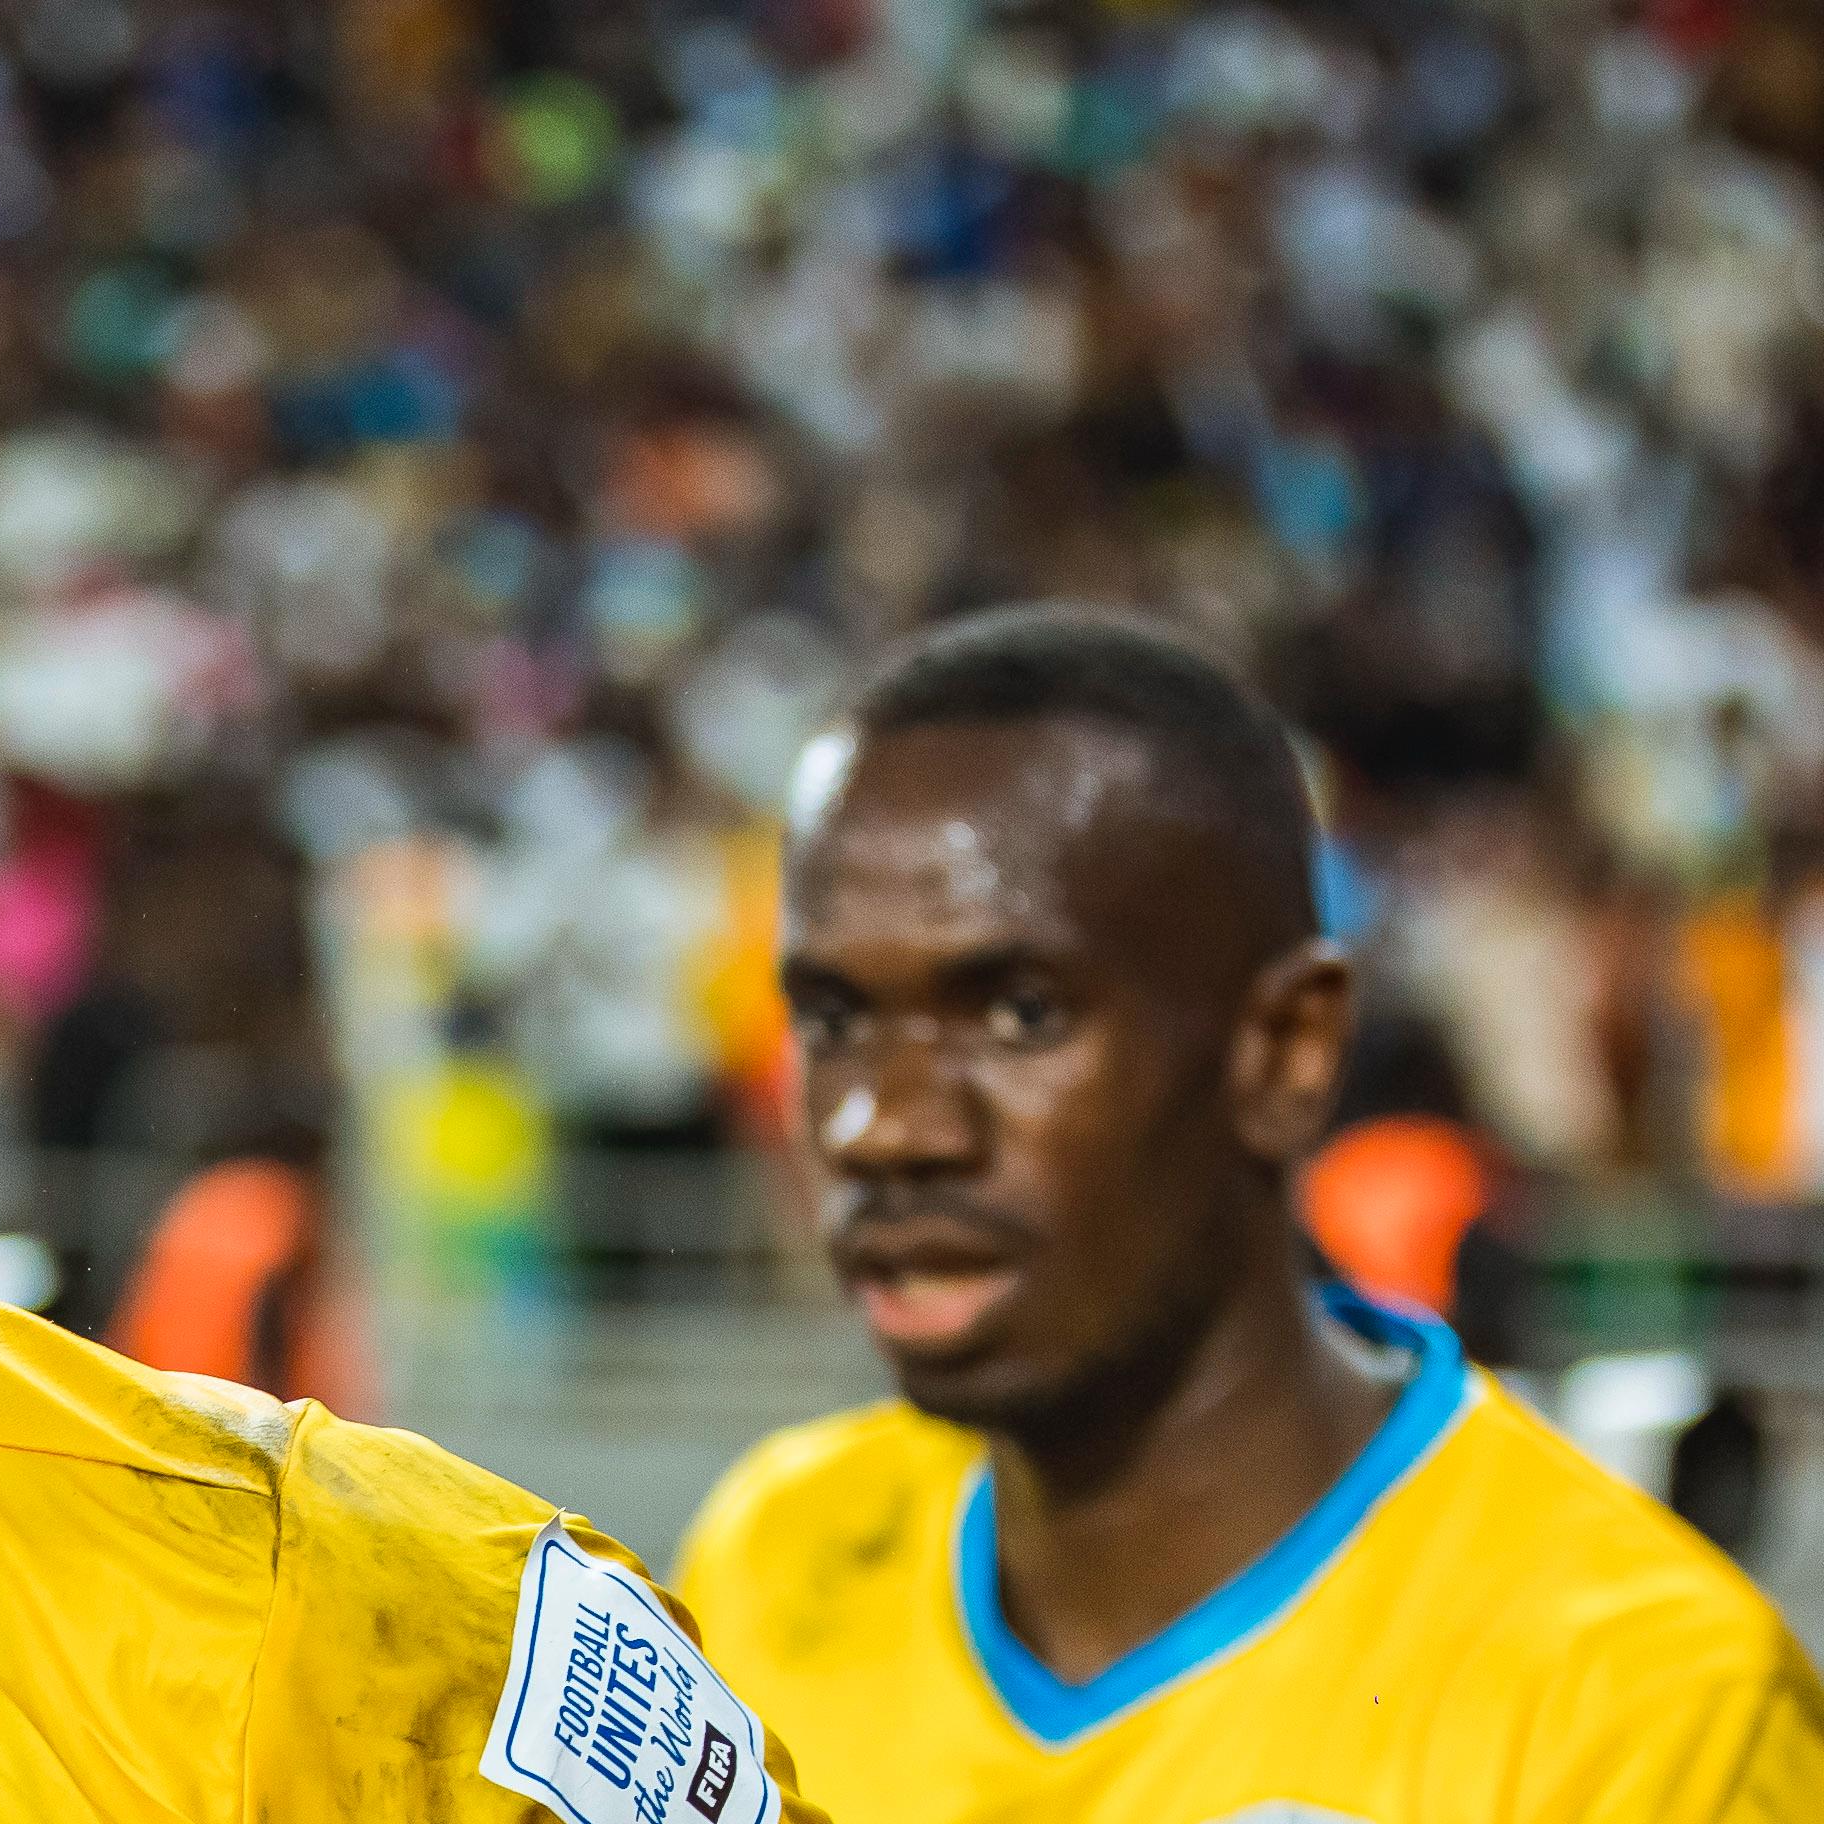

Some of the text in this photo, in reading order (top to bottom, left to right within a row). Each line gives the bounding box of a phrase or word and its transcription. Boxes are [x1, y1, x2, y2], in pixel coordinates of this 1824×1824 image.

[554, 1602, 611, 1758] FOOTBALL
[585, 1622, 658, 1790] UNITES
[650, 1646, 698, 1768] World
[696, 1739, 733, 1808] FIFA
